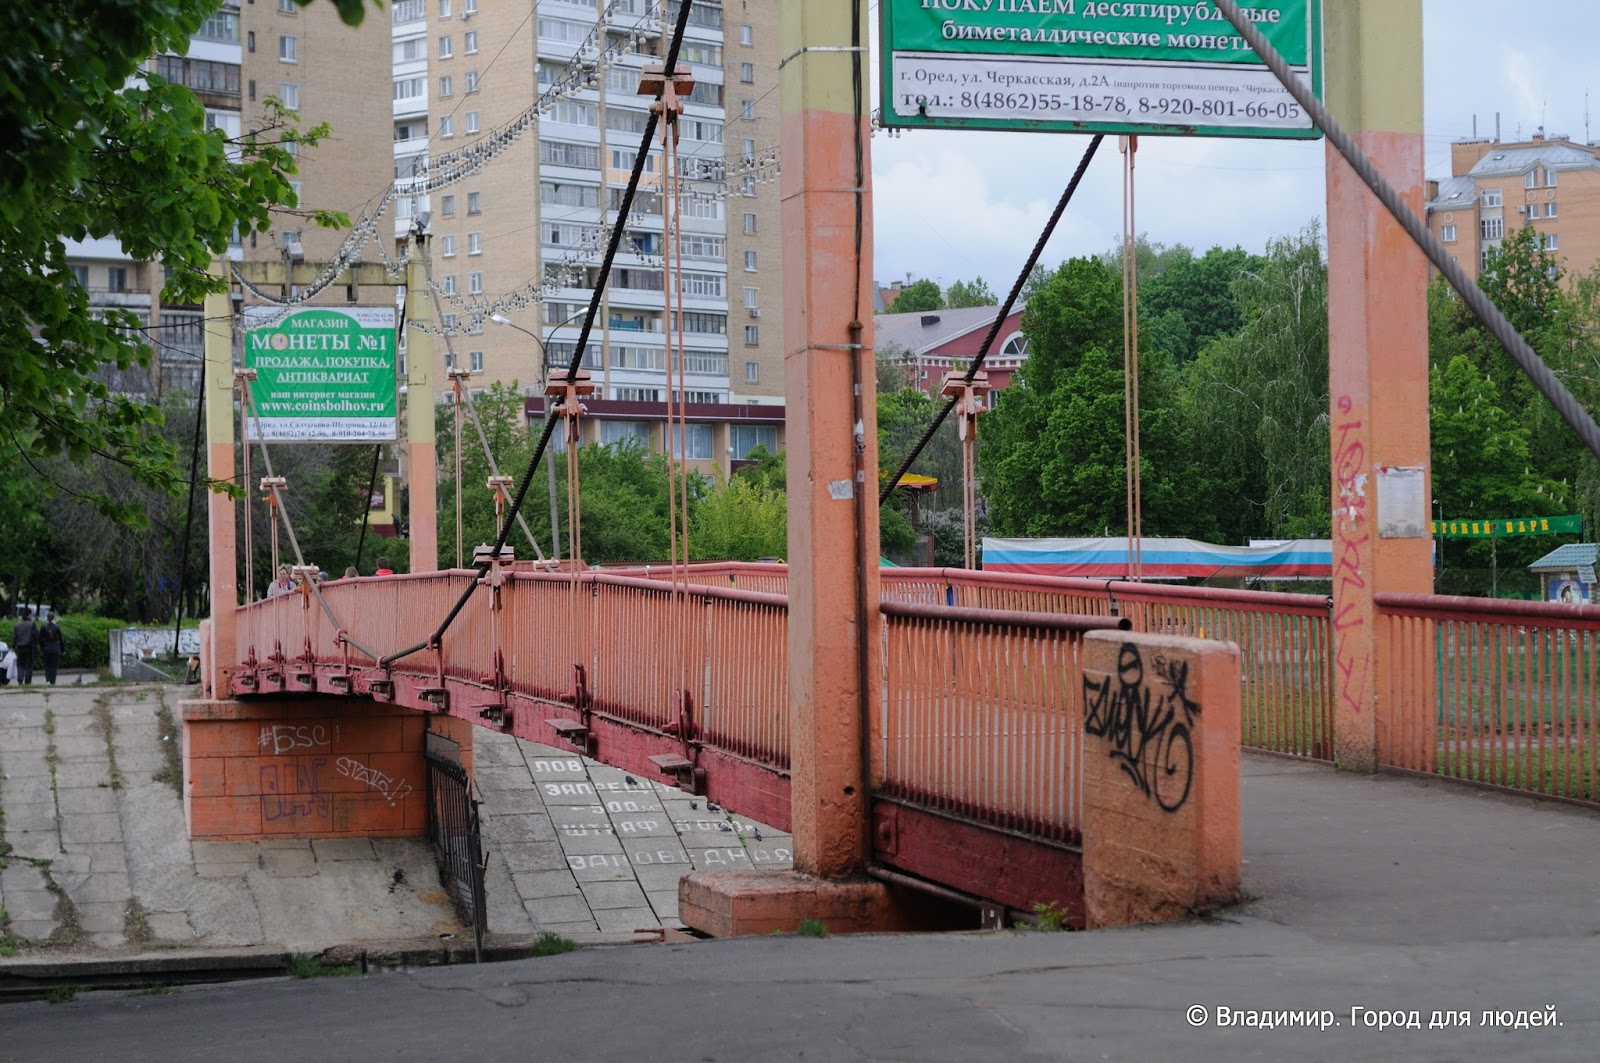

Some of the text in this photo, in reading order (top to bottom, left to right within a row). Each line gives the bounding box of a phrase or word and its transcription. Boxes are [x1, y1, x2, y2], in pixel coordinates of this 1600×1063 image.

[1082, 1, 1280, 26] десятирублвые
[941, 20, 1161, 47] биметаллические
[900, 71, 910, 81] г.
[915, 69, 957, 84] Орел,
[961, 73, 983, 84] ул.
[986, 71, 1075, 88] Черкасская,
[960, 91, 1133, 116] 8(4862)55-18-78,
[1138, 96, 1300, 119] 8-920-801-66-05
[291, 319, 348, 329] МАГАЗИН
[356, 334, 387, 350] №1
[255, 357, 390, 367] ПРОДАЖА, ПОКУПКА,
[277, 372, 369, 383] АНТИКВАРИАТ
[270, 391, 376, 399] наш интернет магазин
[260, 400, 384, 412] www.coinsbolhov.ru
[1505, 519, 1549, 533] ПАРК
[534, 760, 582, 773] ЛОВ
[561, 820, 659, 837] ШТРАФ
